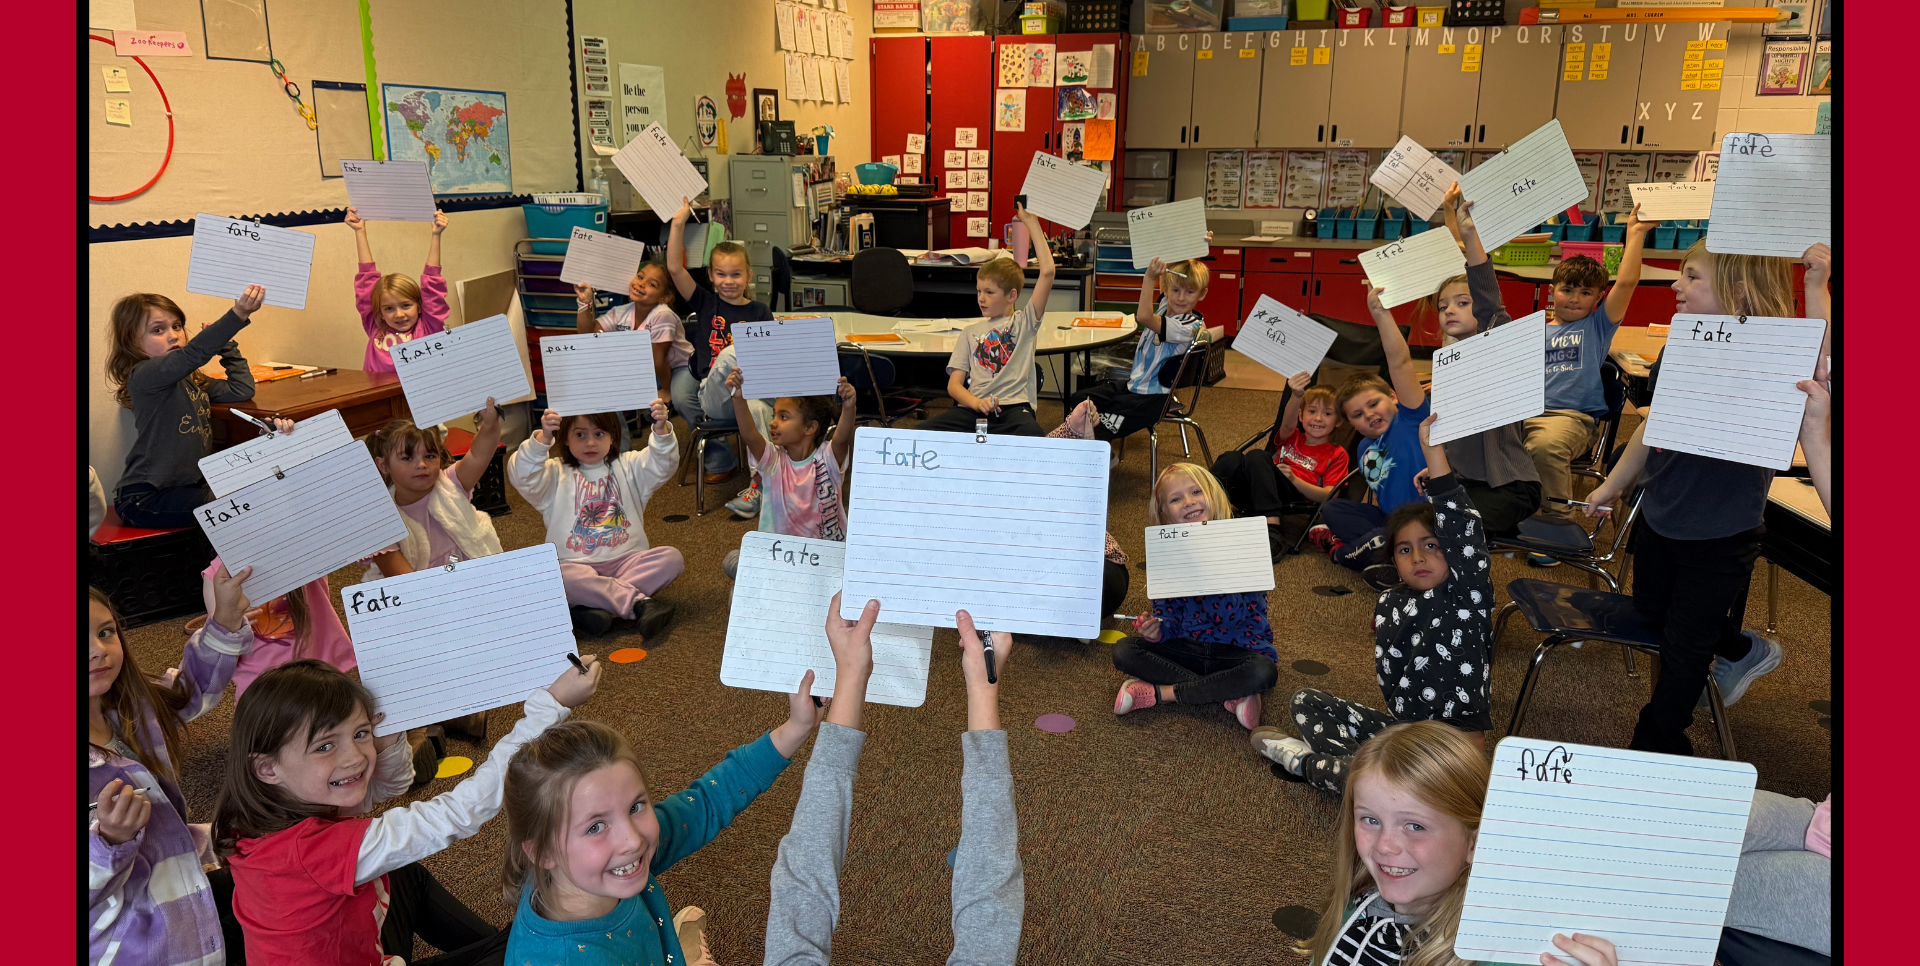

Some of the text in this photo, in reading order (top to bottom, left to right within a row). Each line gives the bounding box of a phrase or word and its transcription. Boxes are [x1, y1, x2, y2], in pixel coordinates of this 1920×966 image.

[1137, 22, 1715, 51] A B C D E F G H I J K L M N O P Q R S T U V W
[624, 83, 646, 96] Be the
[625, 105, 649, 117] person
[1638, 102, 1703, 120] X Y Z
[626, 123, 639, 135] you
[650, 126, 667, 147] fate
[1729, 136, 1776, 158] fate
[343, 161, 363, 174] fate
[1036, 154, 1056, 170] fate
[1416, 179, 1430, 192] fate
[1511, 177, 1537, 196] fate
[1130, 211, 1154, 222] fate
[226, 222, 261, 242] fate
[573, 228, 594, 242] fate
[745, 326, 771, 338] fate
[1266, 327, 1286, 346] fate
[1692, 321, 1733, 343] fate
[1551, 335, 1582, 348] VIEW
[1436, 349, 1461, 367] fate
[876, 436, 940, 471] fate
[204, 498, 252, 528] fate
[1159, 527, 1190, 540] fate
[768, 539, 820, 567] fate
[350, 587, 403, 616] fate
[1517, 748, 1574, 784] fate
